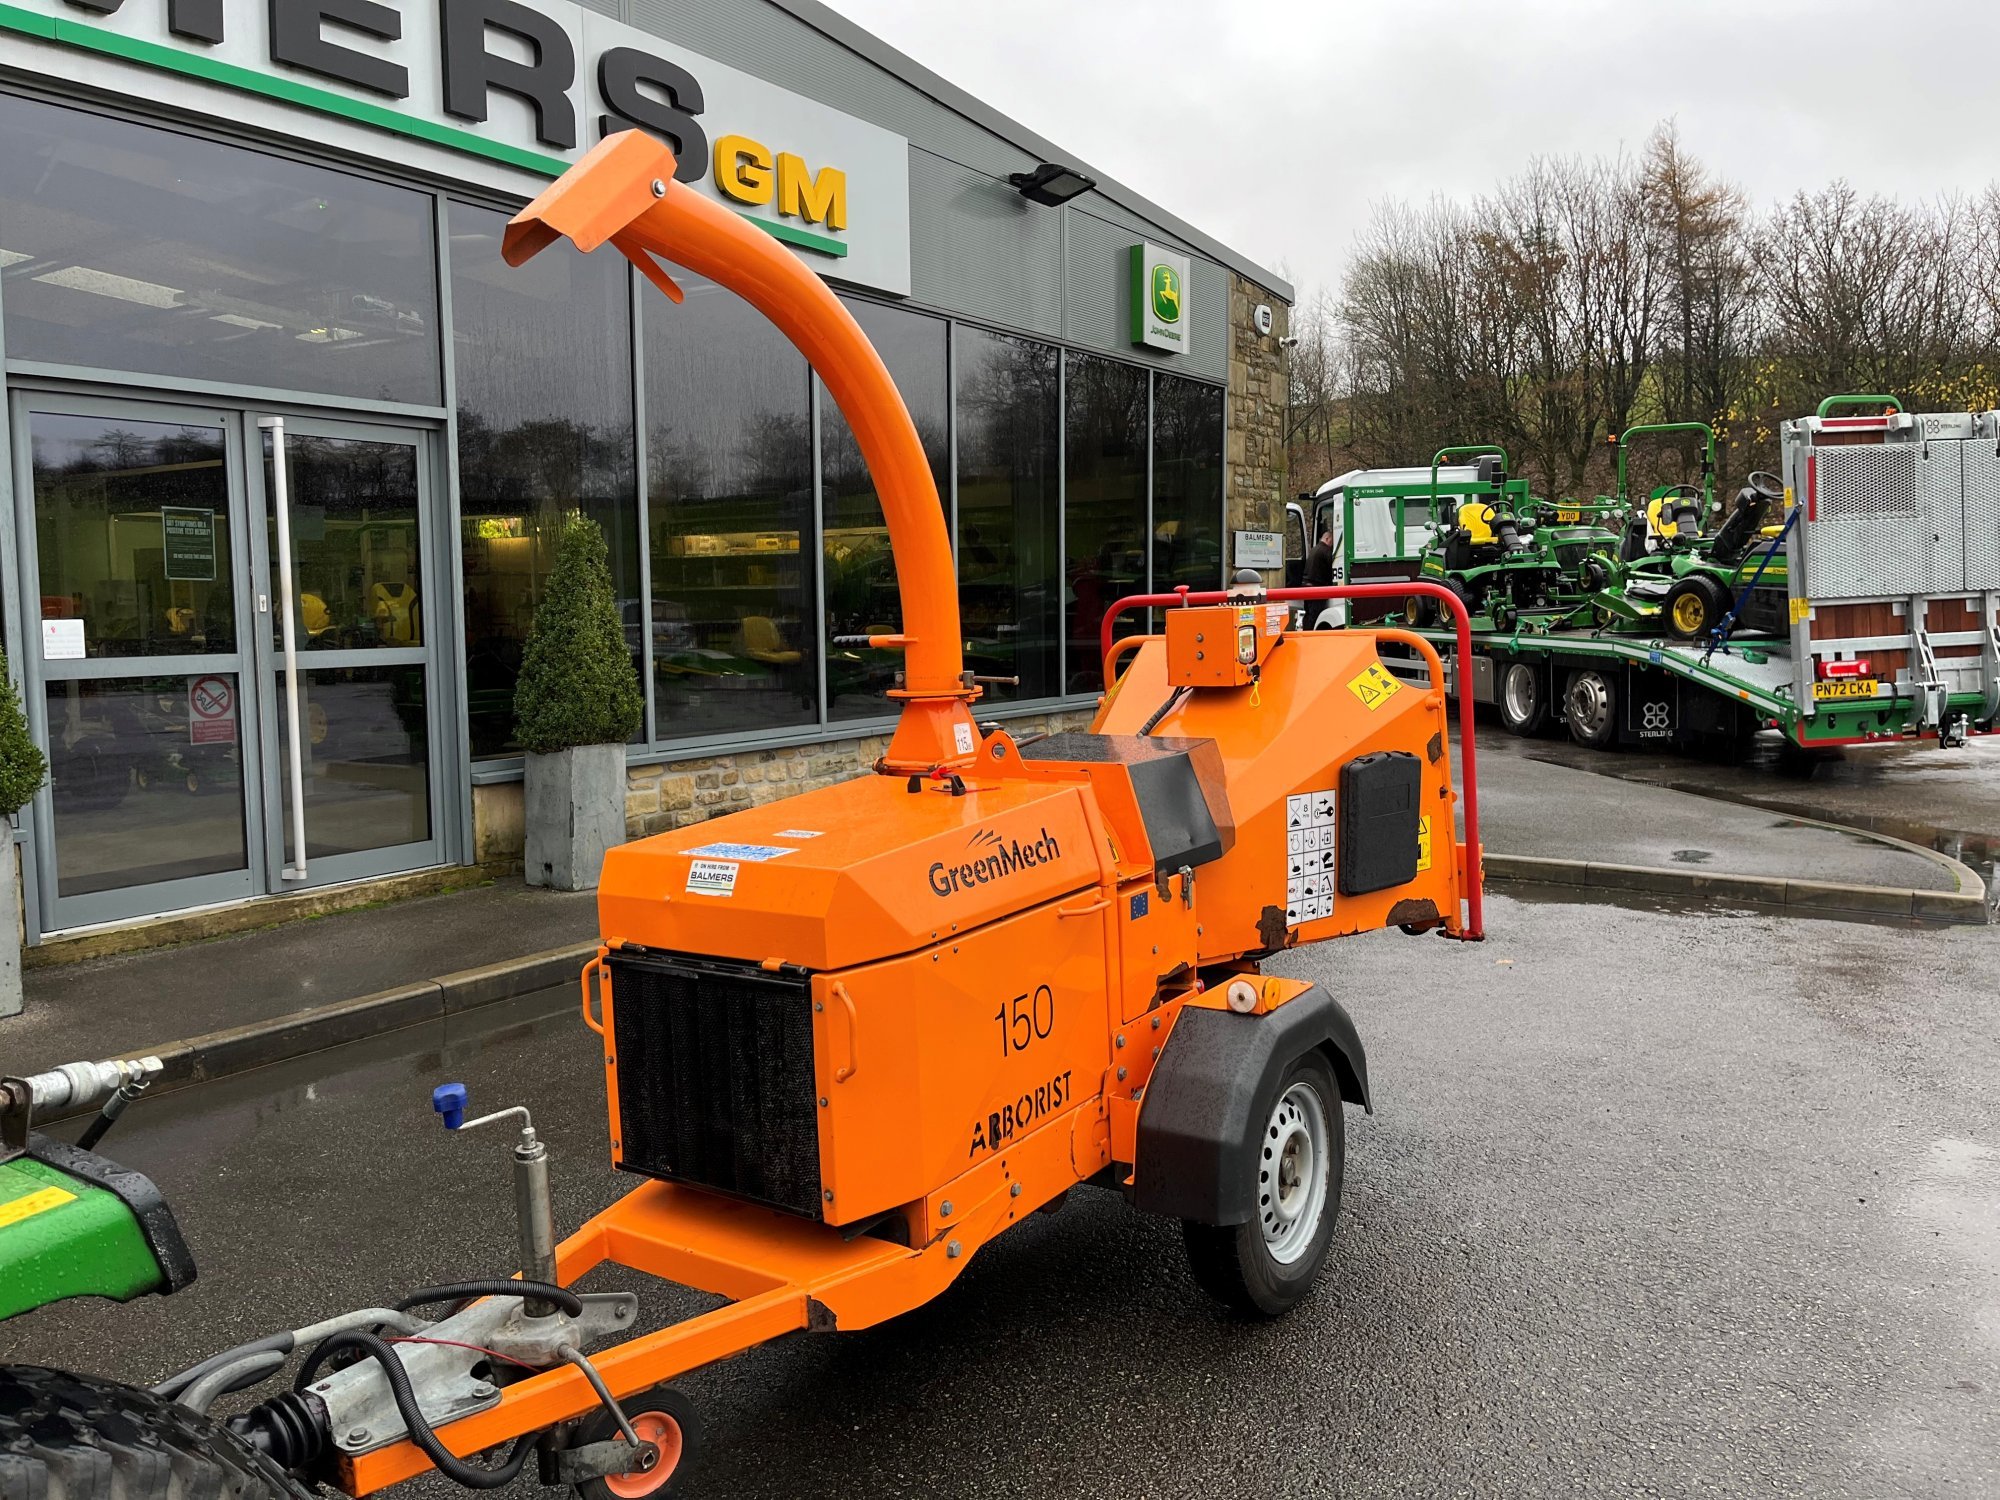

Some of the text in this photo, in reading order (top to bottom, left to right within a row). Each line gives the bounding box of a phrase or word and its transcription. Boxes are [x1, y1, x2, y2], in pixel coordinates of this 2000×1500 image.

[713, 134, 847, 232] GM
[1244, 533, 1273, 541] BALMERS
[1816, 682, 1872, 696] PN72 CKA
[690, 871, 734, 882] BALMERS
[928, 827, 1061, 897] GreenMech
[994, 984, 1054, 1058] 150
[968, 1070, 1072, 1158] ARBORIST
